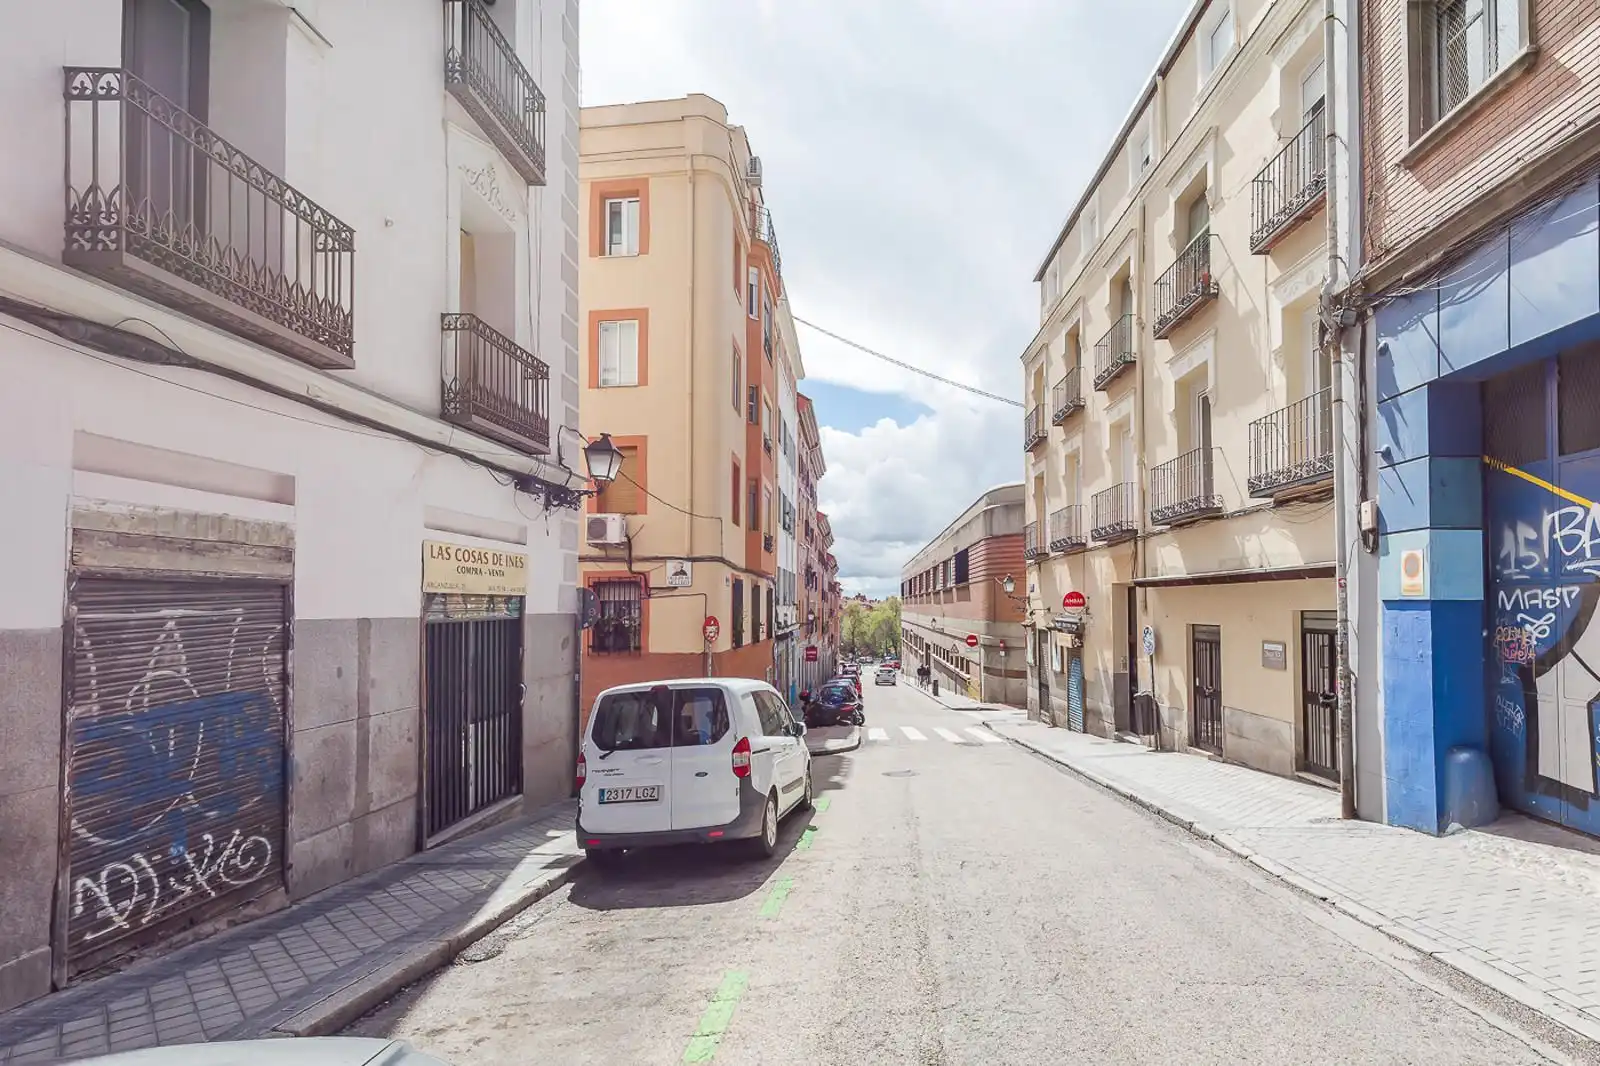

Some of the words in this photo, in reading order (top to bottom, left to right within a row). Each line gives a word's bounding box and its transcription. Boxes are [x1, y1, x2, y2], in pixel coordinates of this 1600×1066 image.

[430, 544, 451, 560] LAS
[455, 548, 489, 565] COSAS
[491, 552, 504, 567] DE
[505, 554, 524, 568] INES
[456, 565, 483, 576] COMPRA
[488, 568, 505, 577] VENTA
[606, 789, 633, 801] 2317
[635, 787, 656, 800] LGZ
